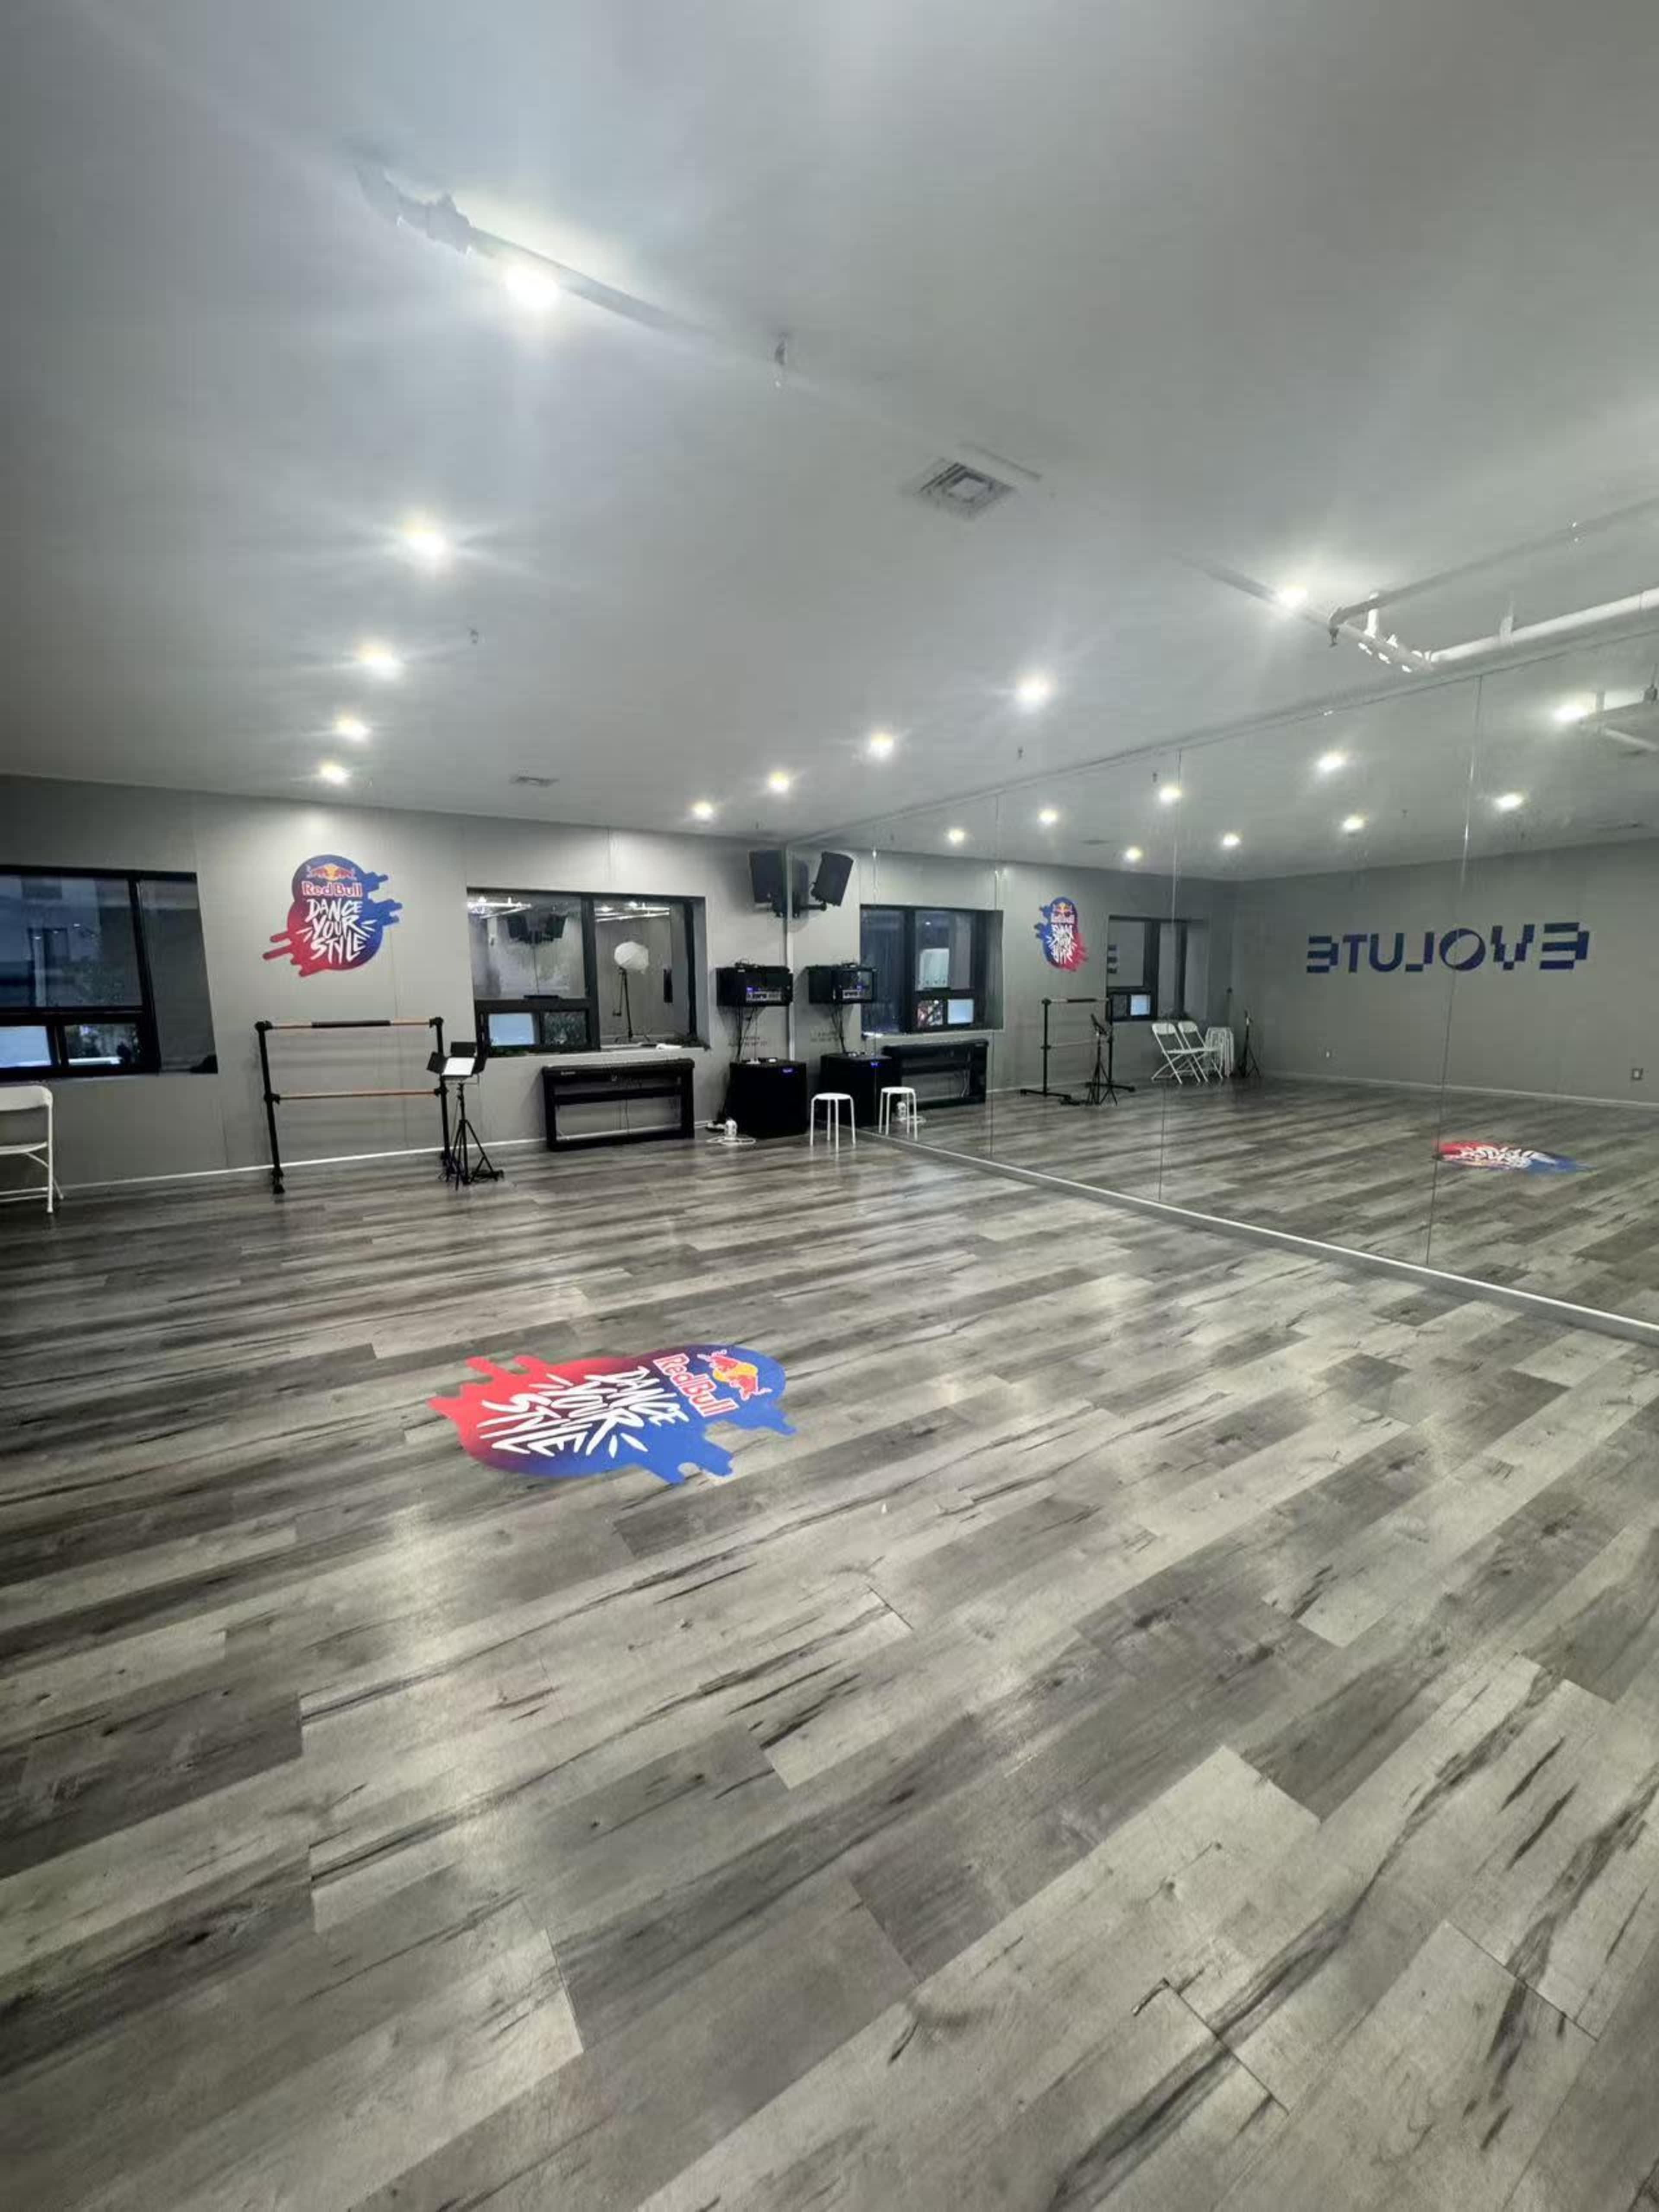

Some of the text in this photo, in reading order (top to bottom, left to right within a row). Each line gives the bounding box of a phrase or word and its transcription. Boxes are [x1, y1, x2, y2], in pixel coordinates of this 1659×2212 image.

[302, 881, 363, 897] Red Bull
[305, 898, 362, 922] DANCE
[312, 915, 370, 940] YOUR
[311, 930, 367, 964] STYLE
[584, 1366, 690, 1426] DANCE
[477, 1393, 593, 1457] STYLE
[538, 1381, 645, 1456] YOUR
